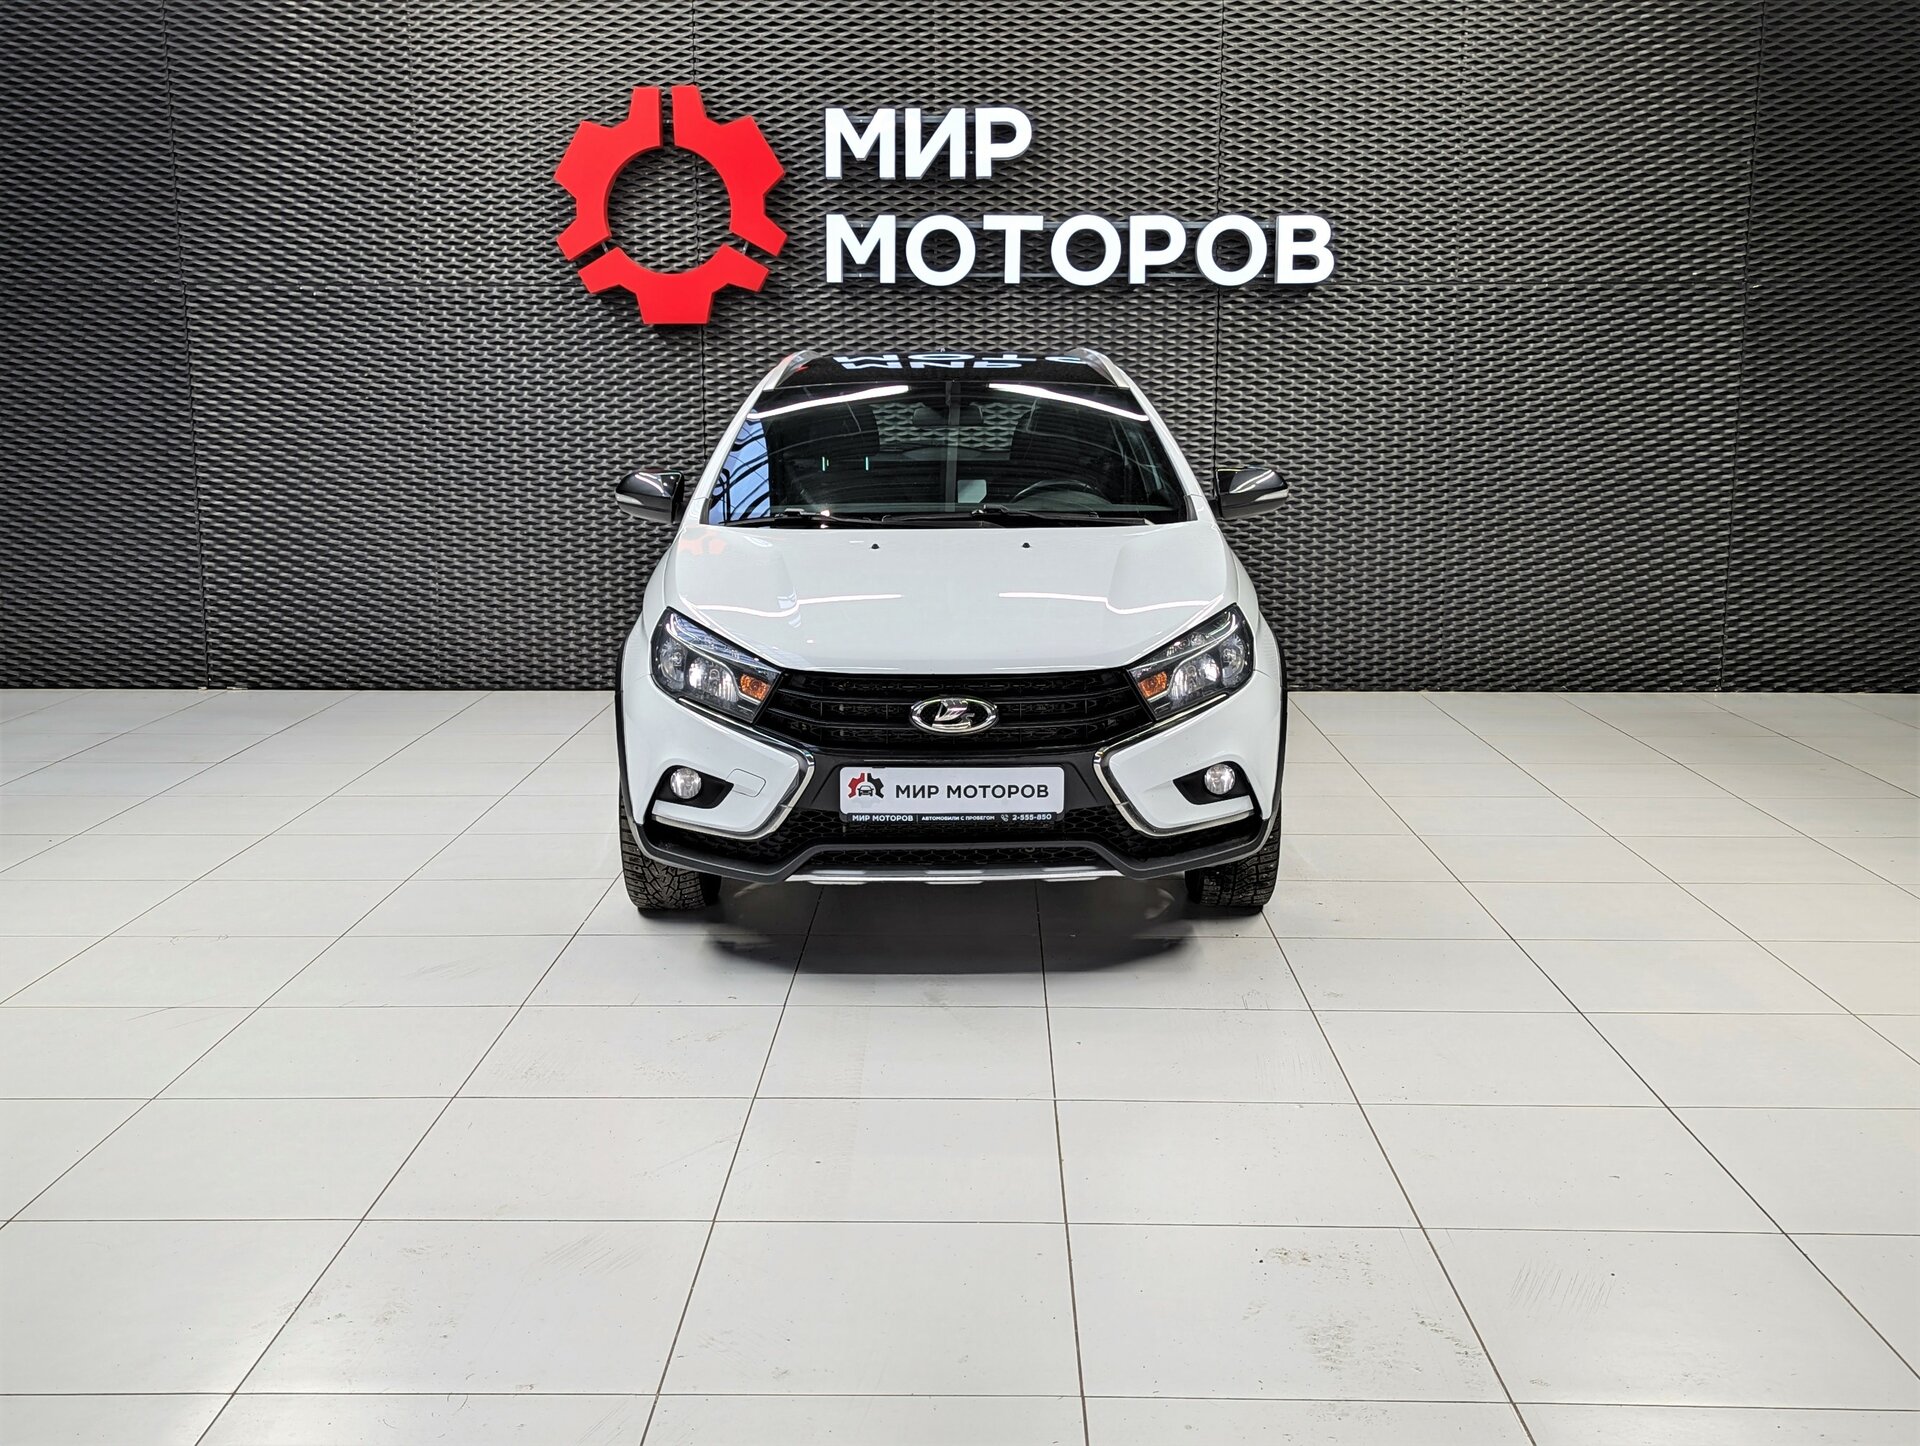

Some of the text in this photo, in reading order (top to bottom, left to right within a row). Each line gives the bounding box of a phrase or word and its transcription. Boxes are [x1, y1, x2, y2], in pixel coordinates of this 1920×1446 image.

[824, 107, 1033, 180] МИР
[824, 213, 1335, 287] МОТОРОВ
[895, 784, 1049, 799] МИР МОТОРОВ
[852, 814, 914, 822] МИР МОТОРОВ
[1012, 813, 1052, 821] 2-555-850
